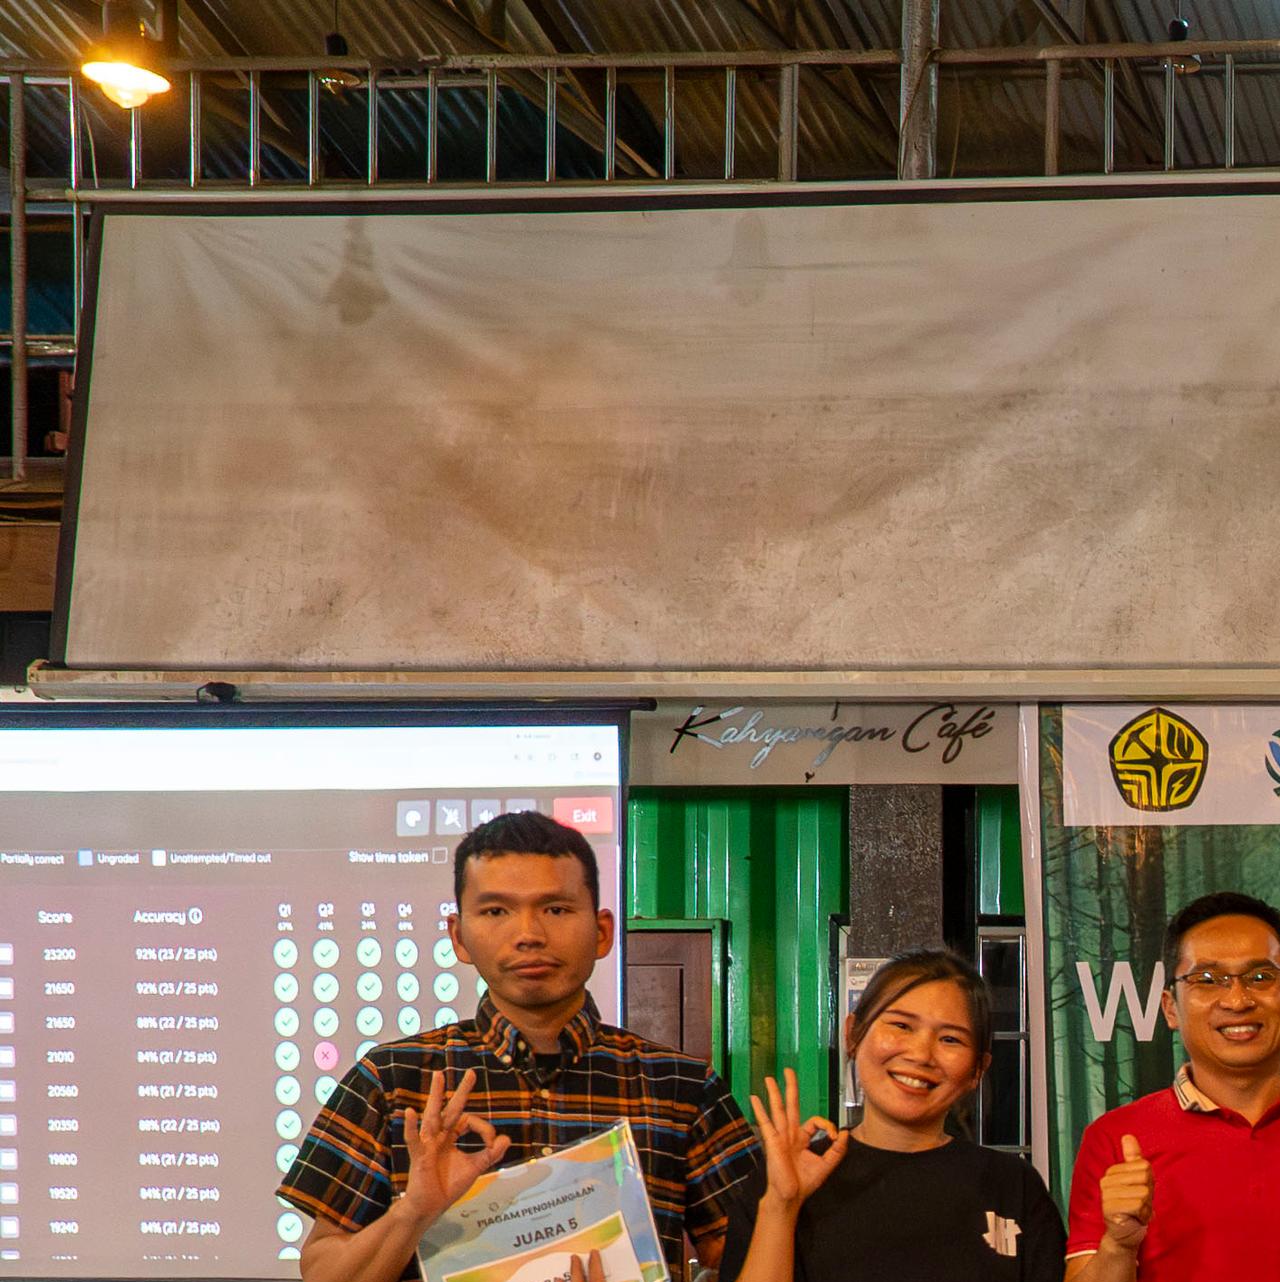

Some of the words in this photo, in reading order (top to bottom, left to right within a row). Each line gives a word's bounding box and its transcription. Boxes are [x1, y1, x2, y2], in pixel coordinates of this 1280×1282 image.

[670, 705, 896, 769] Kahyangan
[902, 702, 996, 763] Café
[573, 809, 597, 822] Exit
[35, 852, 64, 865] correct
[97, 852, 139, 866] Ungraded
[257, 853, 272, 864] out
[349, 851, 374, 863] Show
[375, 851, 396, 863] time
[38, 911, 73, 924] Score
[133, 911, 186, 925] Accuracy
[198, 947, 218, 962] pts)
[198, 982, 218, 996] pts)
[198, 1016, 218, 1031] pts)
[198, 1050, 218, 1065] pts)
[199, 1084, 218, 1100] pts)
[199, 1118, 218, 1133] pts)
[199, 1153, 219, 1168] pts)
[200, 1187, 219, 1202] pts)
[200, 1221, 220, 1236] pts)
[513, 1225, 567, 1248] JUARA
[568, 1217, 579, 1231] 5
